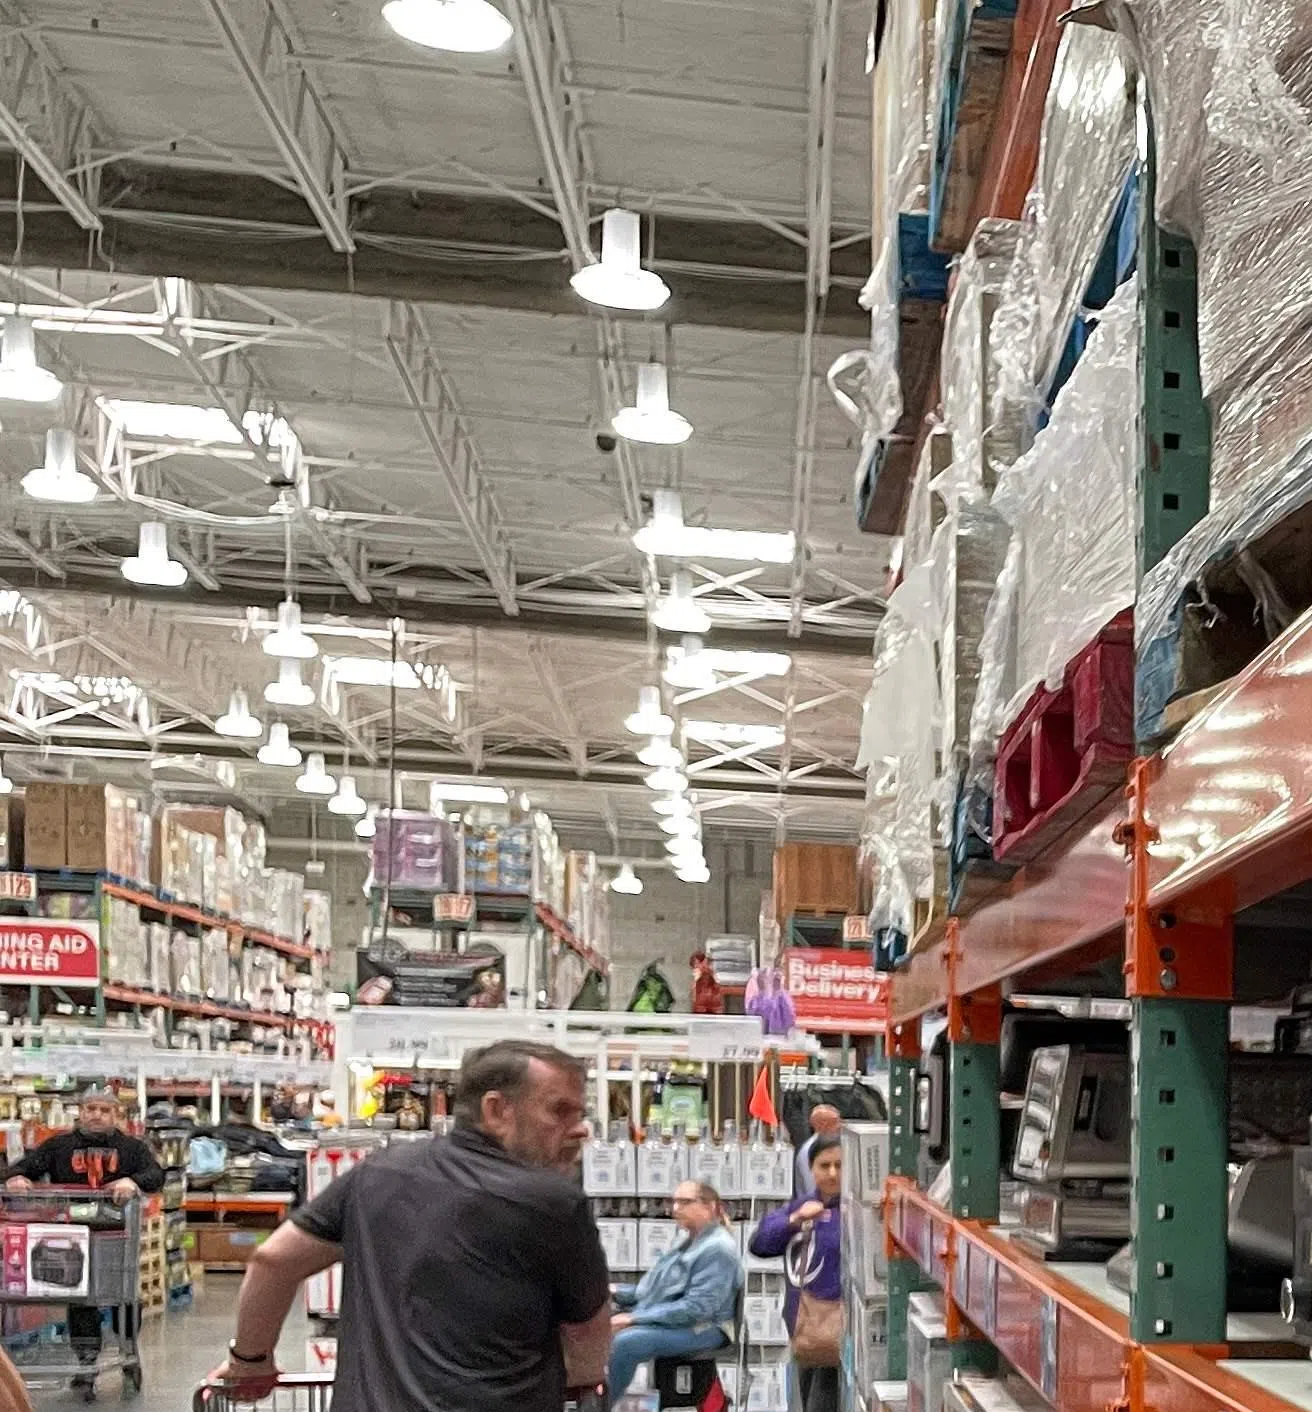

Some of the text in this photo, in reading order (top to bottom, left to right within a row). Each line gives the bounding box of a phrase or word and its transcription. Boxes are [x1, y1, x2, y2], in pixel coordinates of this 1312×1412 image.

[0, 932, 87, 954] ING AID
[1, 951, 60, 972] NTER
[789, 958, 888, 981] Business
[789, 977, 880, 1003] Delivery
